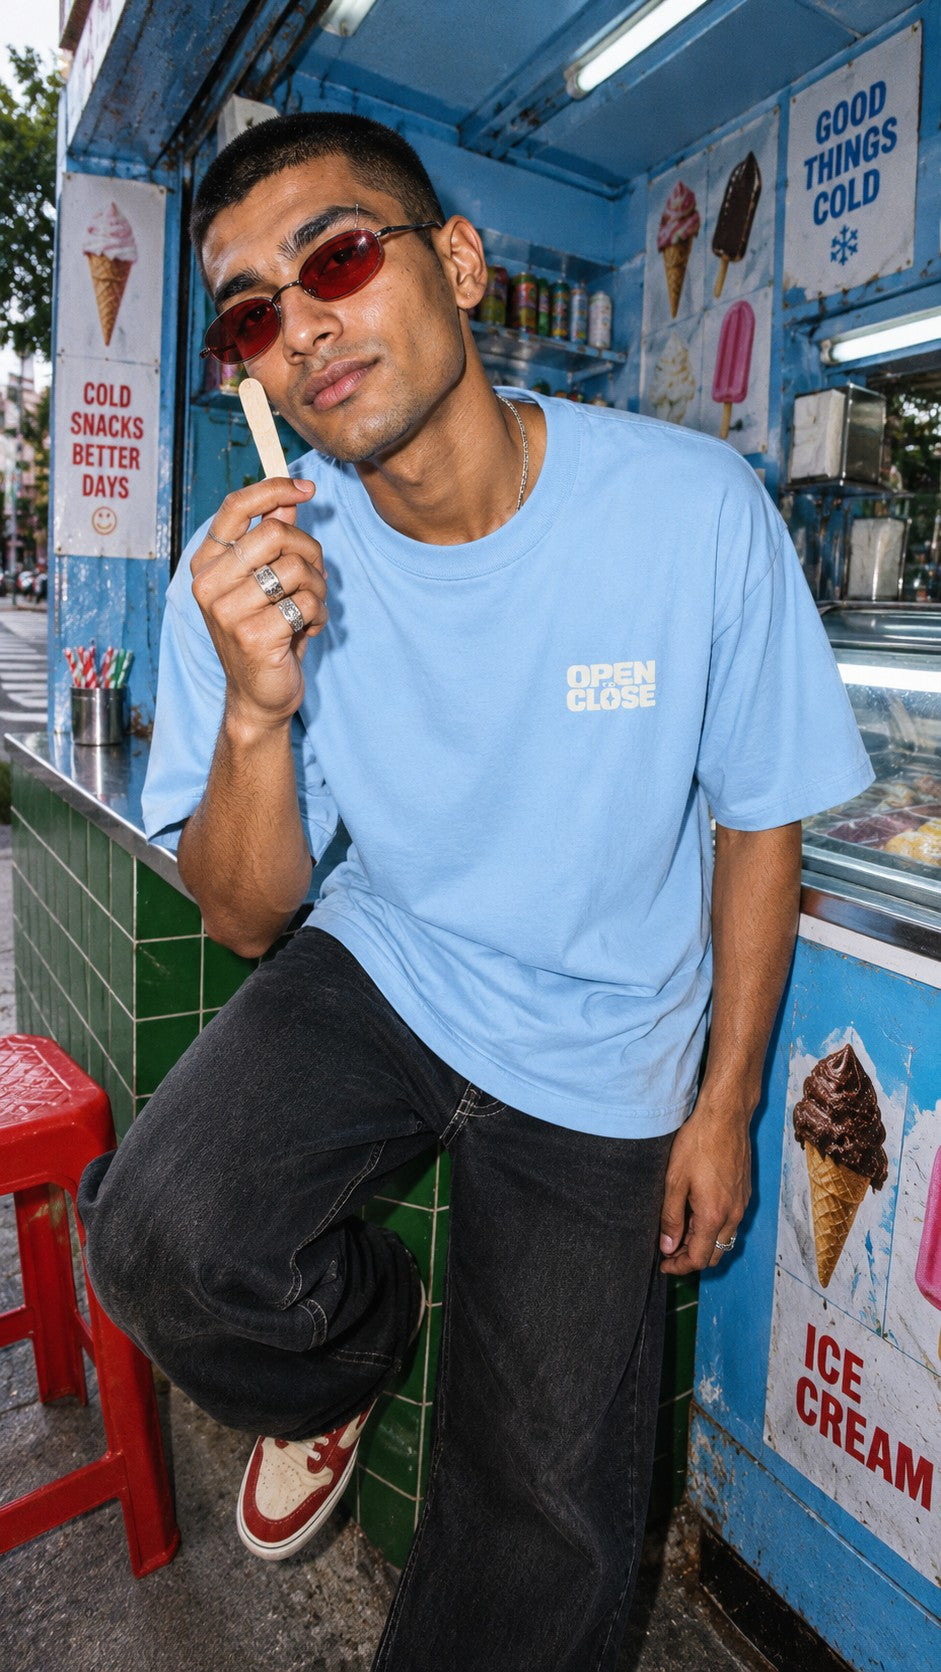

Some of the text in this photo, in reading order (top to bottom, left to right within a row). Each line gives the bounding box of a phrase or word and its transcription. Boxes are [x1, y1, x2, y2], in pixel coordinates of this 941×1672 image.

[816, 80, 887, 145] GOOD
[804, 116, 898, 191] THINGS
[813, 168, 880, 226] COLD
[83, 382, 131, 408] COLD
[70, 411, 144, 440] SNACKS
[72, 443, 140, 470] BETTER
[82, 474, 129, 499] DAYS
[566, 660, 656, 688] OPEN
[566, 683, 656, 712] CLOSE
[804, 1322, 864, 1404] ICE
[796, 1376, 934, 1512] CREAM
